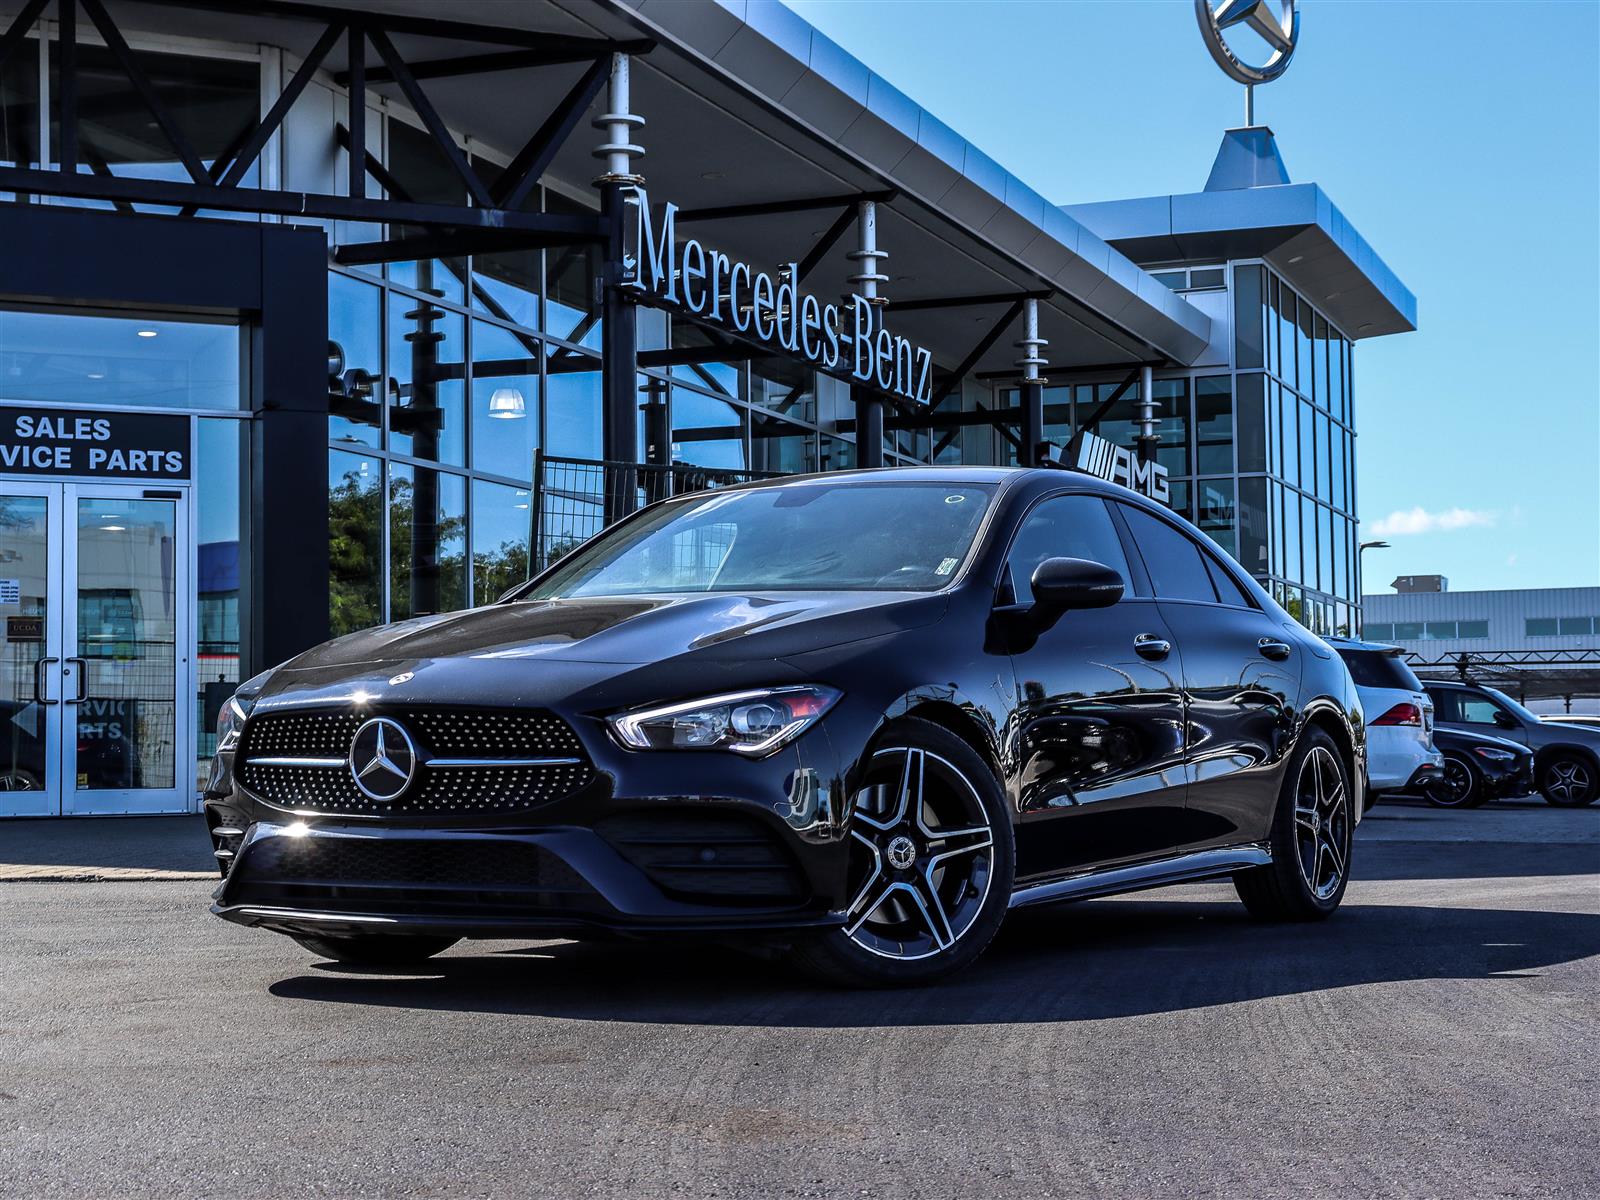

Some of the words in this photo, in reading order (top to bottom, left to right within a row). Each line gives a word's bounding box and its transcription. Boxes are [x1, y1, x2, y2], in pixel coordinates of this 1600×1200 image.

[618, 185, 932, 406] Mercedes-Benz
[15, 415, 111, 441] SALES
[89, 448, 183, 473] PARTS
[1109, 445, 1170, 504] AMG
